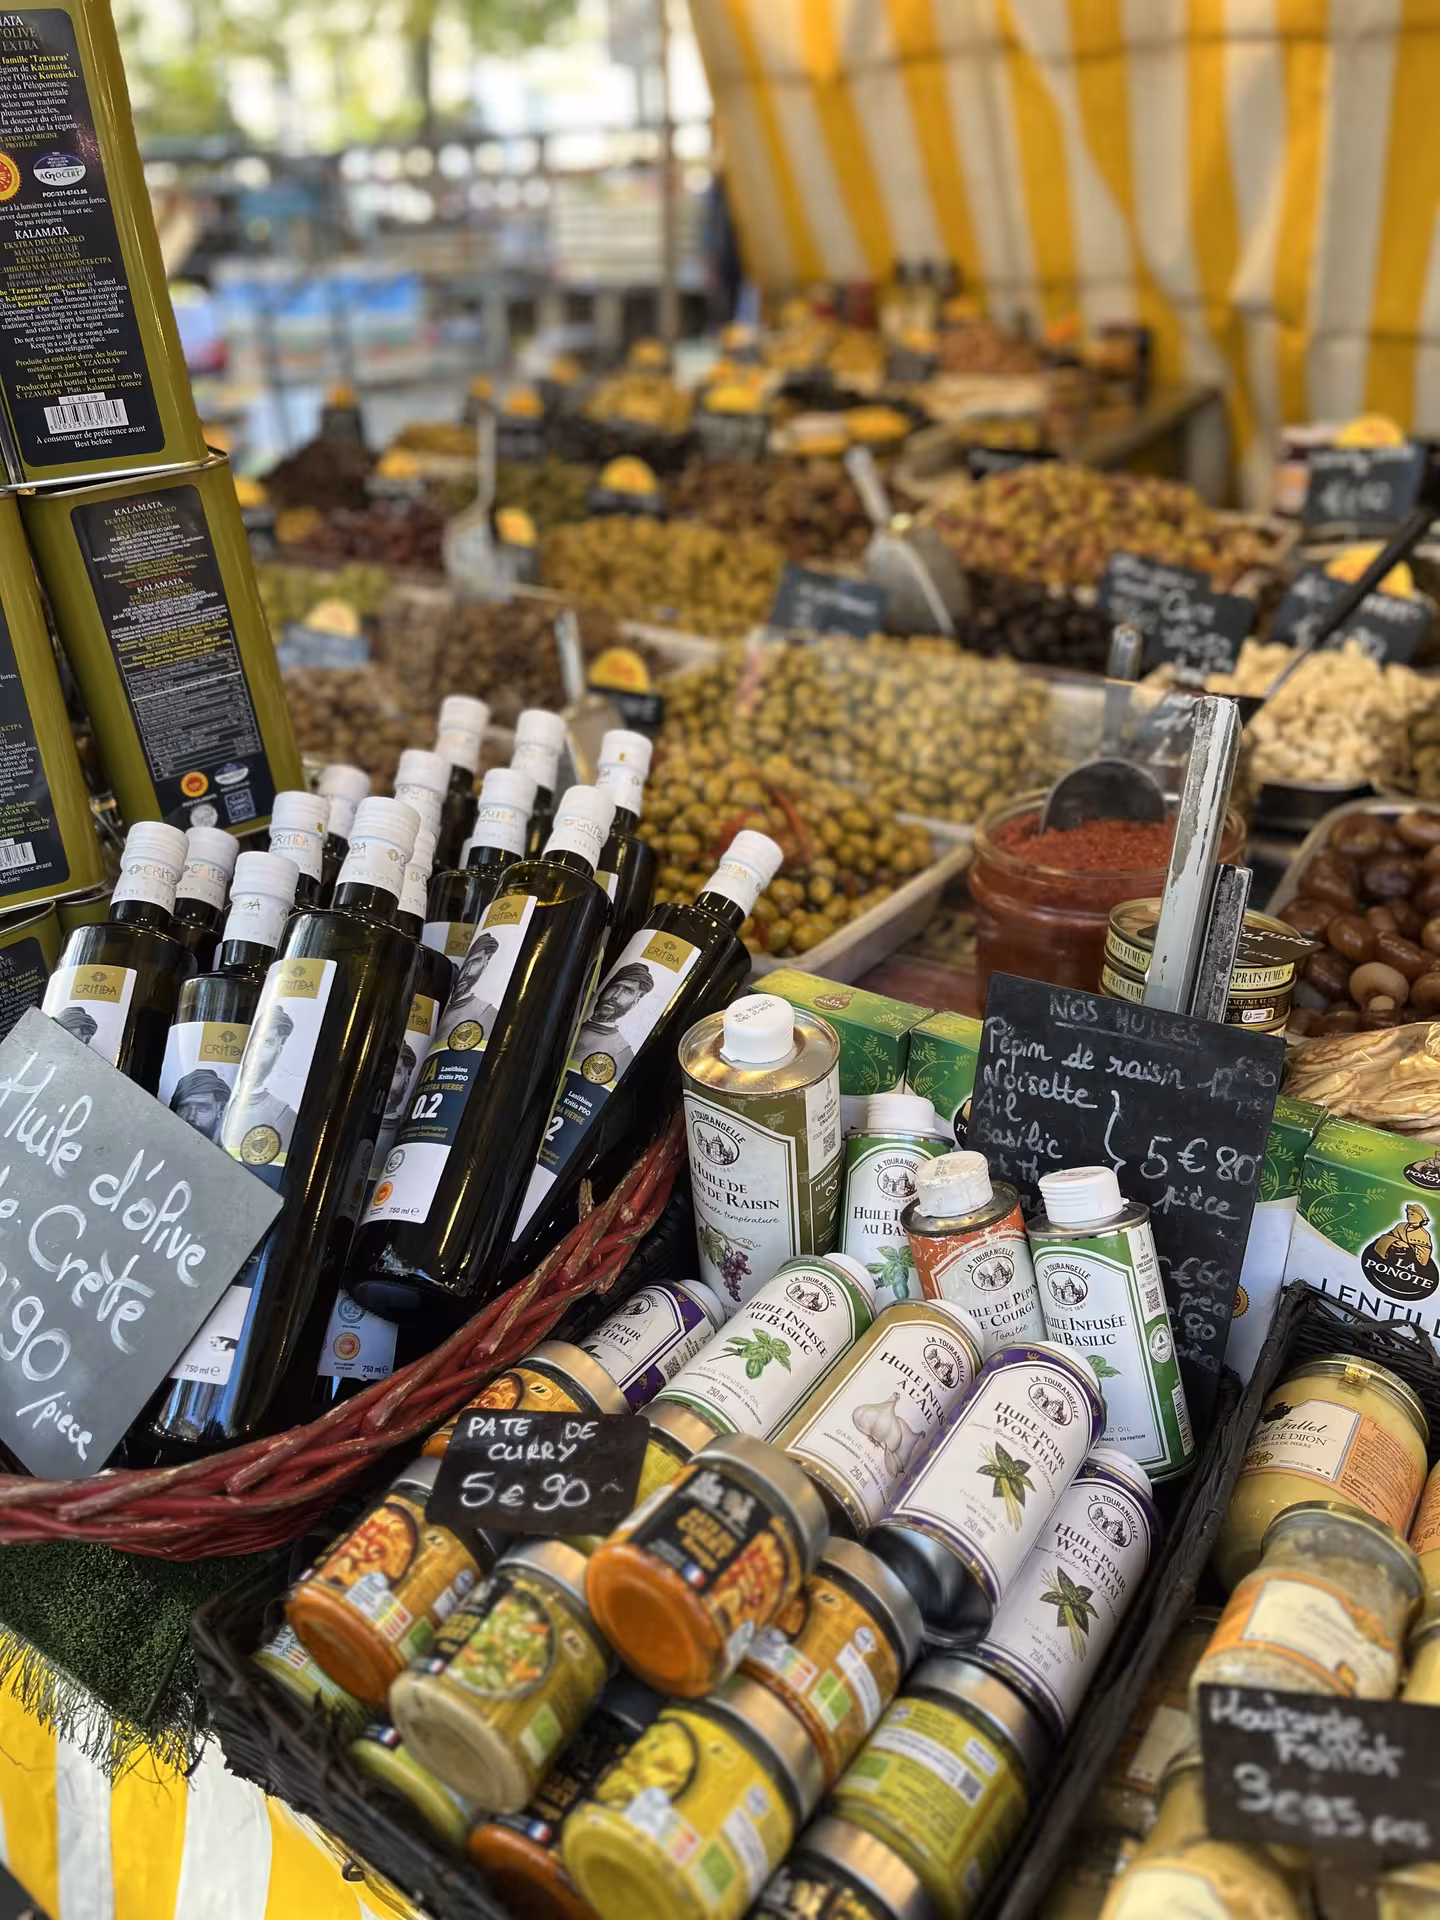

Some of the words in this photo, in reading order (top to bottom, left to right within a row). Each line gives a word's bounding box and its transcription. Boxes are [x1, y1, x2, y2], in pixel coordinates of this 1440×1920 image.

[14, 226, 70, 240] KALAMATA
[15, 381, 49, 392] Produced
[43, 434, 83, 445] consommer
[128, 425, 147, 434] avant
[74, 440, 91, 449] Best
[91, 437, 113, 446] before
[113, 501, 163, 517] KALAMATA
[136, 577, 185, 594] KALAMATA
[647, 943, 681, 966] CRITIDA
[75, 983, 117, 997] CRITIDA
[1062, 1043, 1095, 1071] de
[441, 1082, 465, 1092] VIERGE
[984, 1058, 1099, 1109] Noisette
[411, 1092, 444, 1121] 0.2
[564, 1108, 586, 1126] VIERGE
[693, 1109, 747, 1144] TOURANGELLE
[692, 1156, 726, 1189] HUILE
[874, 1163, 883, 1174] LA
[883, 1158, 919, 1172] TOURANGEL
[1405, 1168, 1440, 1184] PONOT
[707, 1186, 722, 1202] DE
[726, 1191, 780, 1210] RAISIN
[388, 1207, 402, 1215] 750
[853, 1206, 894, 1221] HUILE
[861, 1224, 879, 1235] AU
[965, 1265, 975, 1274] LA
[972, 1248, 1015, 1268] TOURANGELLE
[1047, 1262, 1092, 1281] TOURANGELLE
[1395, 1256, 1417, 1273] LA
[1364, 1258, 1434, 1289] PONOTE
[802, 1275, 837, 1308] TOURANGELLE
[991, 1303, 1037, 1326] COURGE
[995, 1300, 1012, 1314] DE
[614, 1322, 642, 1342] POUR
[744, 1300, 786, 1316] HUILE
[784, 1309, 829, 1359] INFUSÉE
[744, 1311, 766, 1321] AU
[766, 1314, 813, 1356] BASILIC
[1068, 1313, 1128, 1332] INFUSÉE
[1063, 1331, 1117, 1347] BASILIC
[185, 1363, 199, 1374] 750
[199, 1365, 209, 1375] ml
[362, 1364, 374, 1373] 750
[938, 1337, 965, 1385] TOURANGELLE
[706, 1385, 721, 1398] 250
[716, 1394, 728, 1403] ml
[879, 1351, 924, 1387] HUILE
[921, 1381, 946, 1426] INFUS
[1029, 1375, 1042, 1383] LA
[1043, 1375, 1080, 1421] TOURANGELLE
[896, 1377, 909, 1391] À
[908, 1387, 934, 1425] L'AIL
[467, 1416, 532, 1439] PATE
[564, 1420, 600, 1441] DE
[993, 1401, 1040, 1434] HUILE
[1039, 1430, 1067, 1471] POUR
[995, 1413, 1032, 1444] WOK
[1275, 1418, 1329, 1434] Fallot
[835, 1428, 864, 1451] GARLIC
[1271, 1432, 1287, 1441] DE
[1289, 1432, 1328, 1446] DIJON
[487, 1440, 578, 1462] CURRY
[849, 1464, 863, 1481] 250
[858, 1478, 869, 1489] ml
[963, 1516, 978, 1532] 250
[1088, 1494, 1100, 1502] LA
[1101, 1494, 1139, 1541] TOURANGELLE
[1053, 1522, 1101, 1557] HUILE
[1100, 1553, 1127, 1594] POUR
[1056, 1535, 1092, 1568] WOK
[1029, 1648, 1044, 1665] 250
[1041, 1660, 1053, 1673] ml
